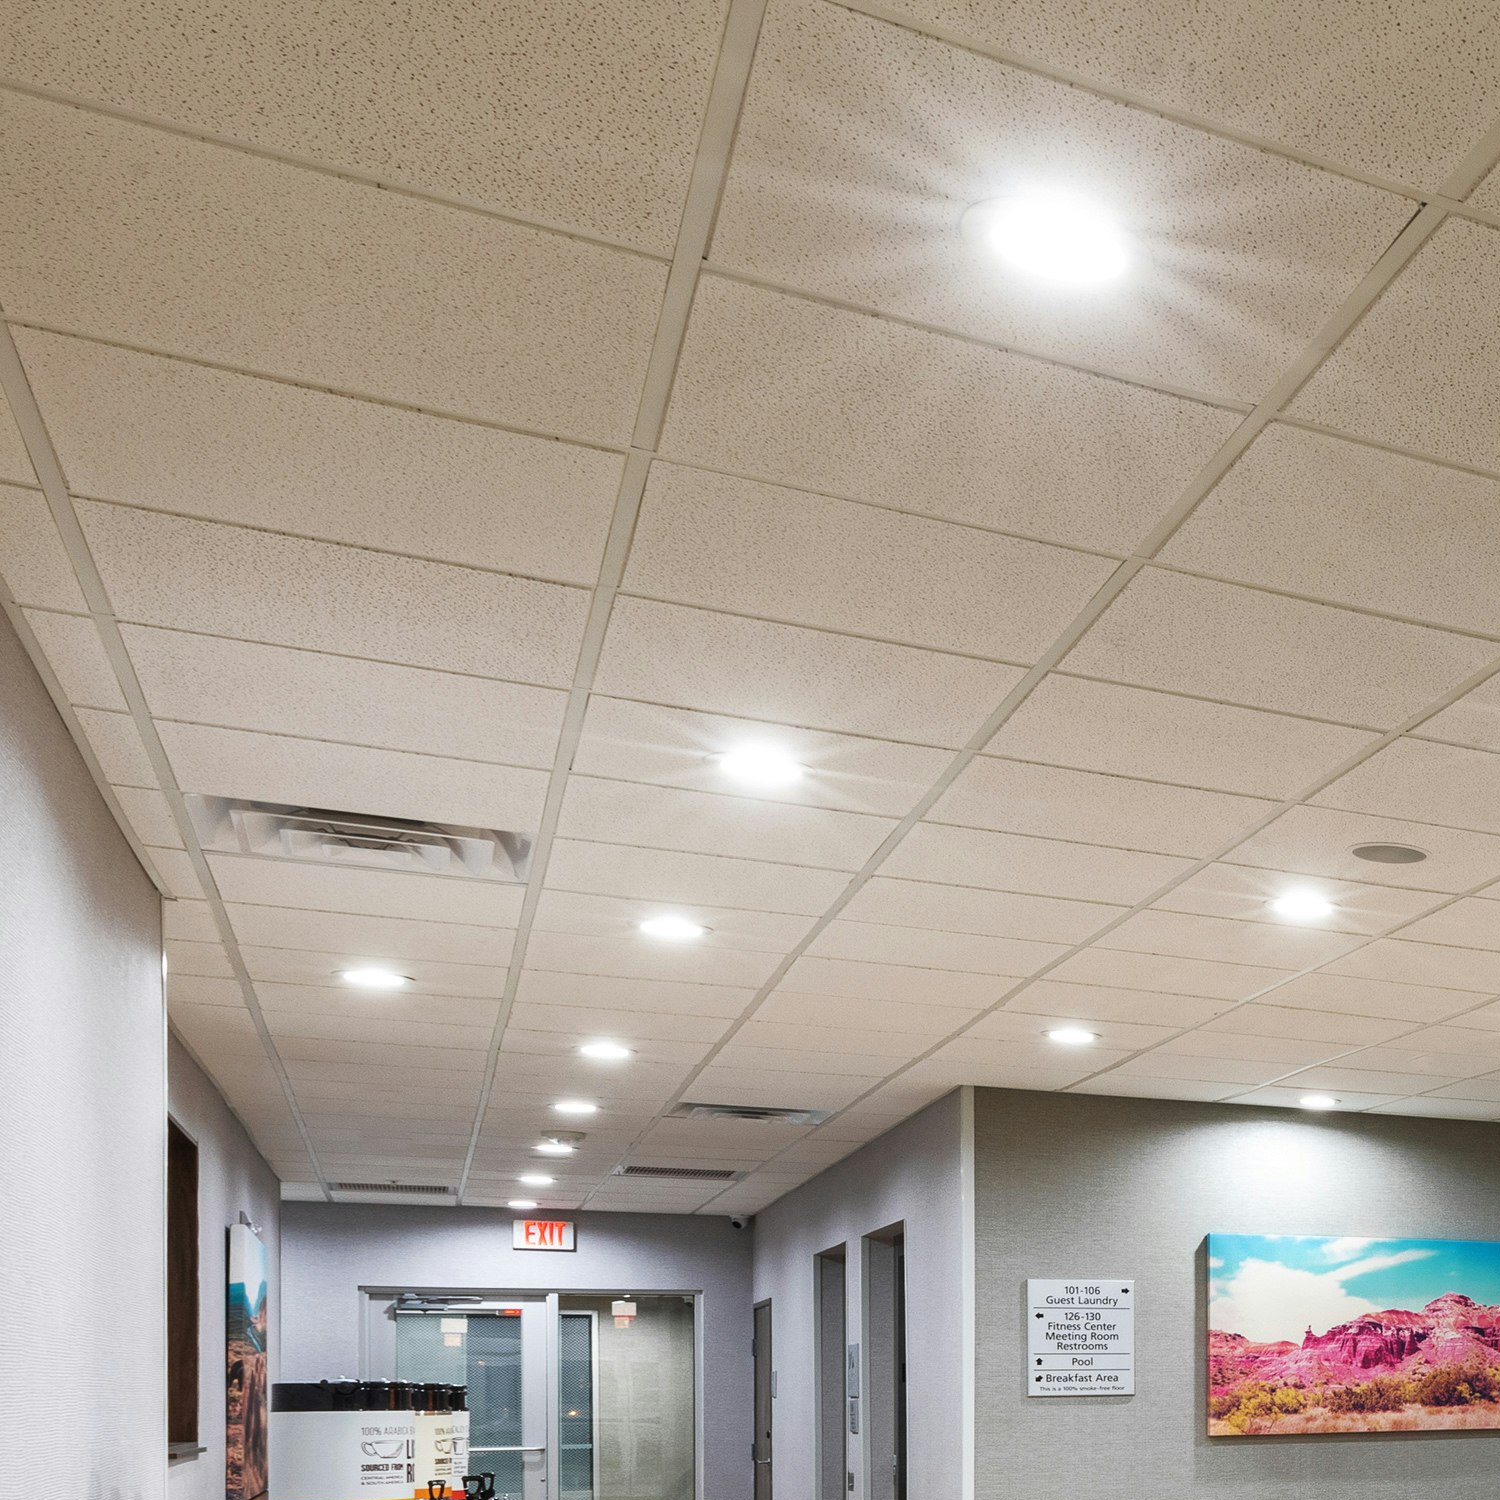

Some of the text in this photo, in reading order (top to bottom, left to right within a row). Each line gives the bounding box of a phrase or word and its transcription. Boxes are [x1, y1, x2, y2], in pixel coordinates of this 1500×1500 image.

[524, 1220, 567, 1247] EXIT
[1064, 1286, 1101, 1295] 101-106
[1046, 1296, 1119, 1307] Guest Laundry
[1064, 1312, 1102, 1321] 126-130
[1047, 1322, 1117, 1331] Fitness Center
[1045, 1332, 1119, 1342] Meeting Room
[1056, 1342, 1109, 1351] Restrooms
[1071, 1357, 1094, 1366] Pool
[1046, 1374, 1119, 1383] Breakfast Area
[361, 1427, 382, 1436] 100%
[361, 1464, 389, 1472] SOURCED
